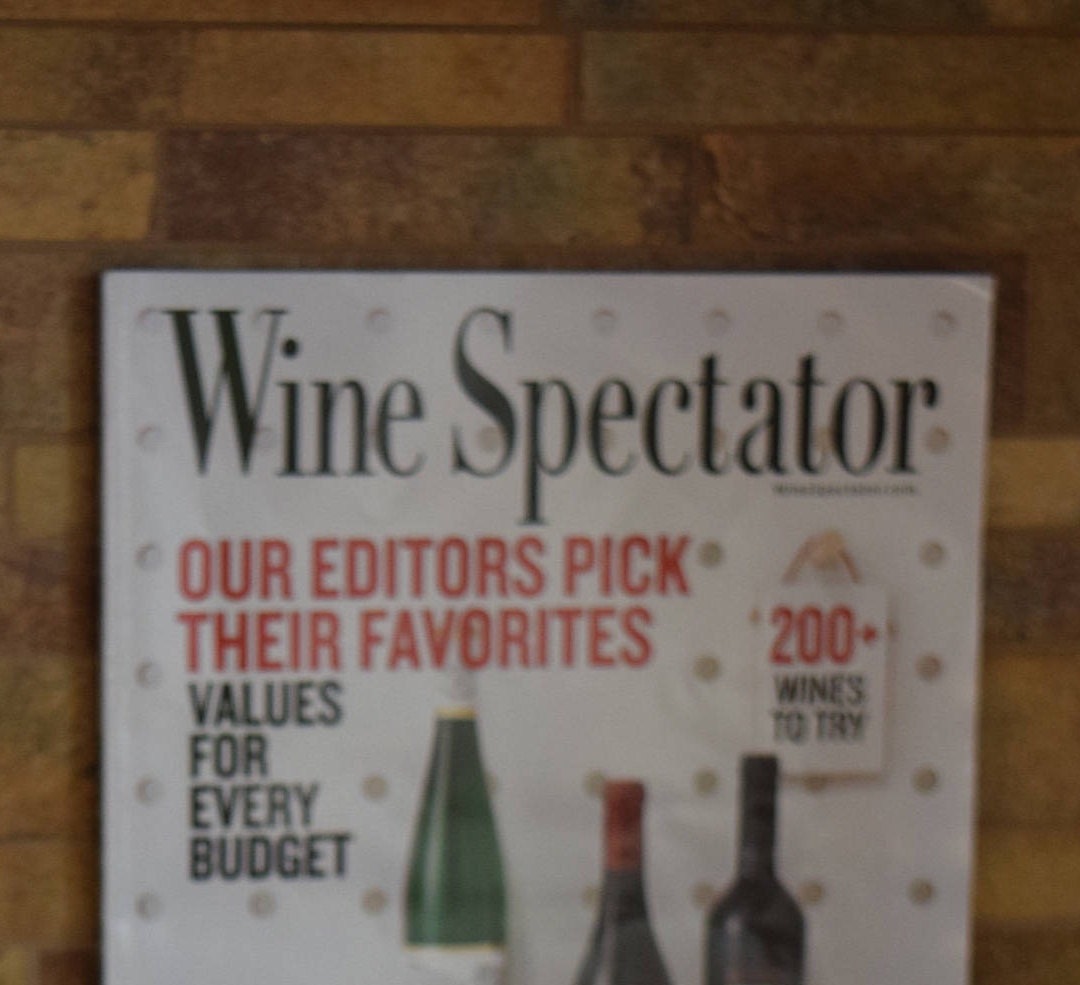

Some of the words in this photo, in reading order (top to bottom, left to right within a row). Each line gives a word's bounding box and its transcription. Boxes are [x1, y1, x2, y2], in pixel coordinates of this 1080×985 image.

[161, 308, 426, 478] Wine
[450, 305, 940, 526] Spectator
[178, 536, 293, 601] OUR
[310, 536, 547, 598] EDITORS
[563, 534, 692, 596] PICK
[176, 610, 342, 673] THEIR
[359, 606, 655, 671] FAVORITES
[188, 681, 343, 727] VALUES
[774, 674, 865, 707] WINES
[773, 711, 805, 743] TO
[816, 709, 865, 741] TRY
[189, 733, 269, 780] FOR
[189, 784, 318, 831] EVERY
[189, 833, 352, 882] BUDGET
